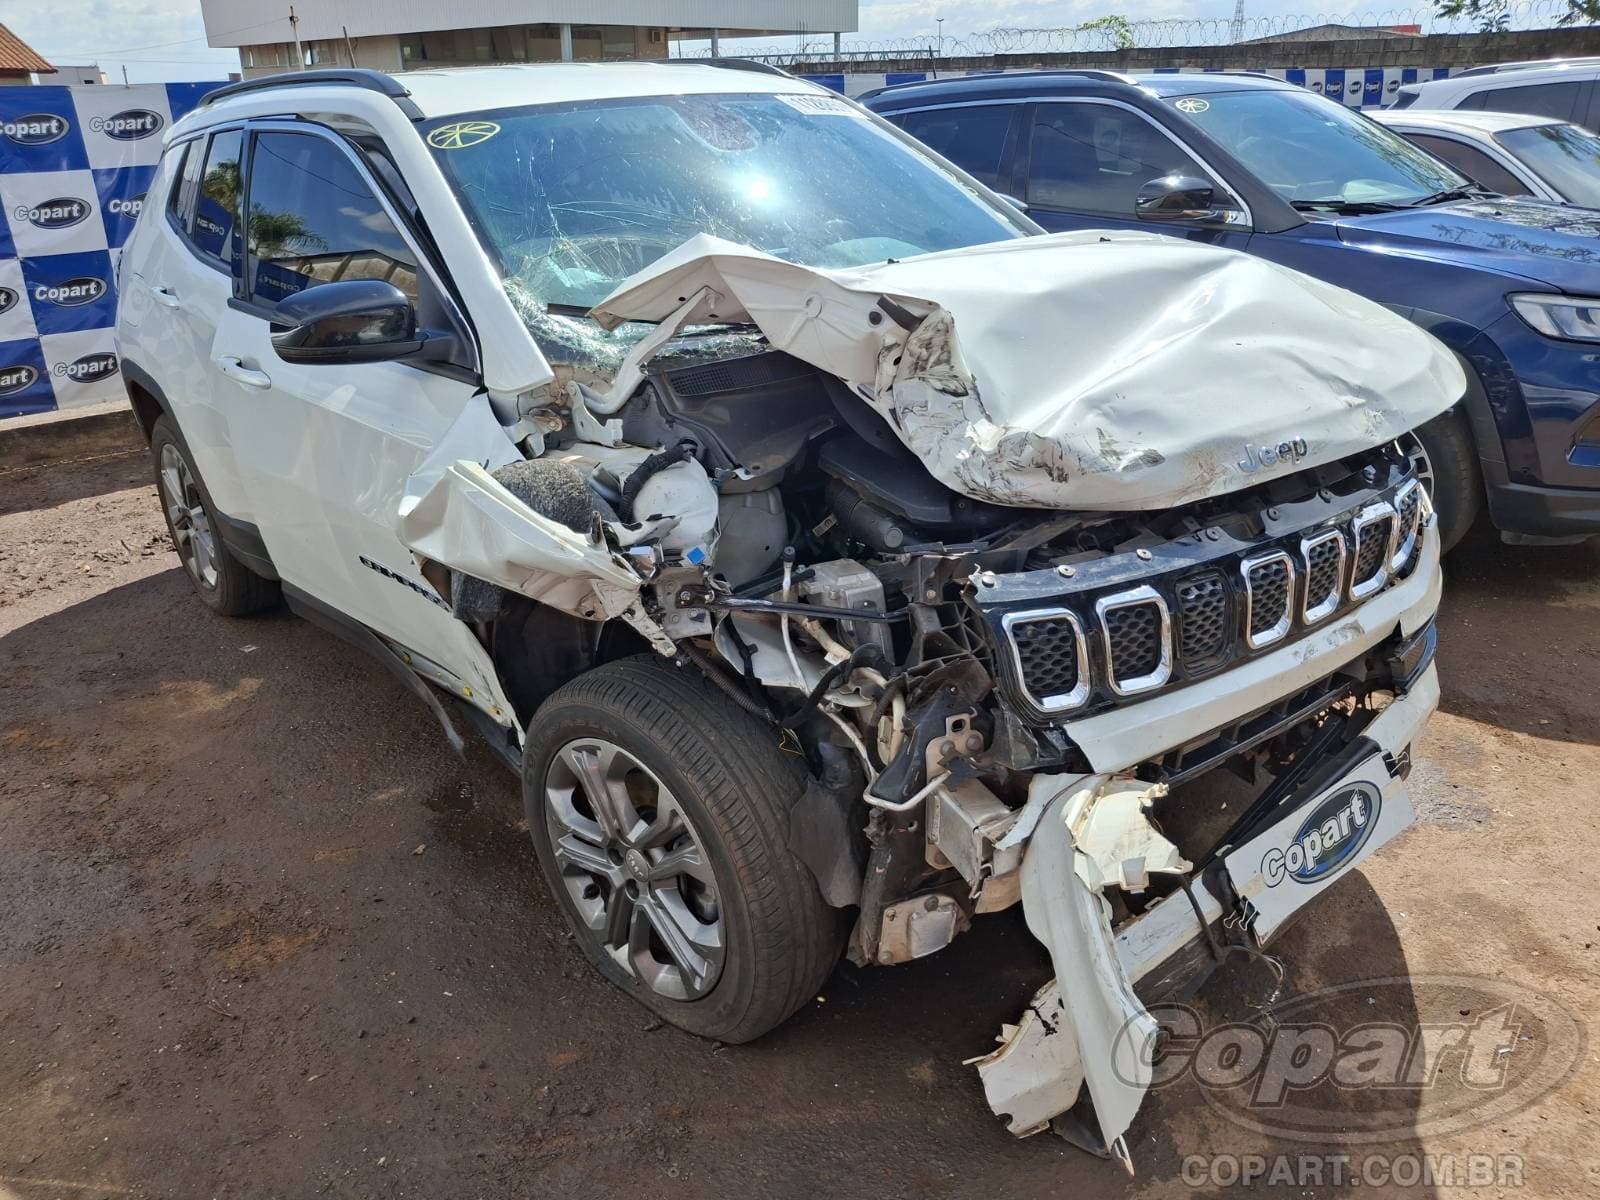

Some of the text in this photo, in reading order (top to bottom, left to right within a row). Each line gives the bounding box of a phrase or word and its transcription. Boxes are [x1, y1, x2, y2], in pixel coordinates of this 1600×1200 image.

[0, 118, 60, 138] opart
[89, 115, 154, 135] Copart
[14, 204, 81, 223] Copart
[109, 199, 143, 215] Cop
[35, 281, 98, 301] Copart
[0, 369, 30, 386] art
[54, 356, 115, 379] Copart
[1238, 437, 1308, 473] Jeep
[1261, 787, 1368, 888] Copart
